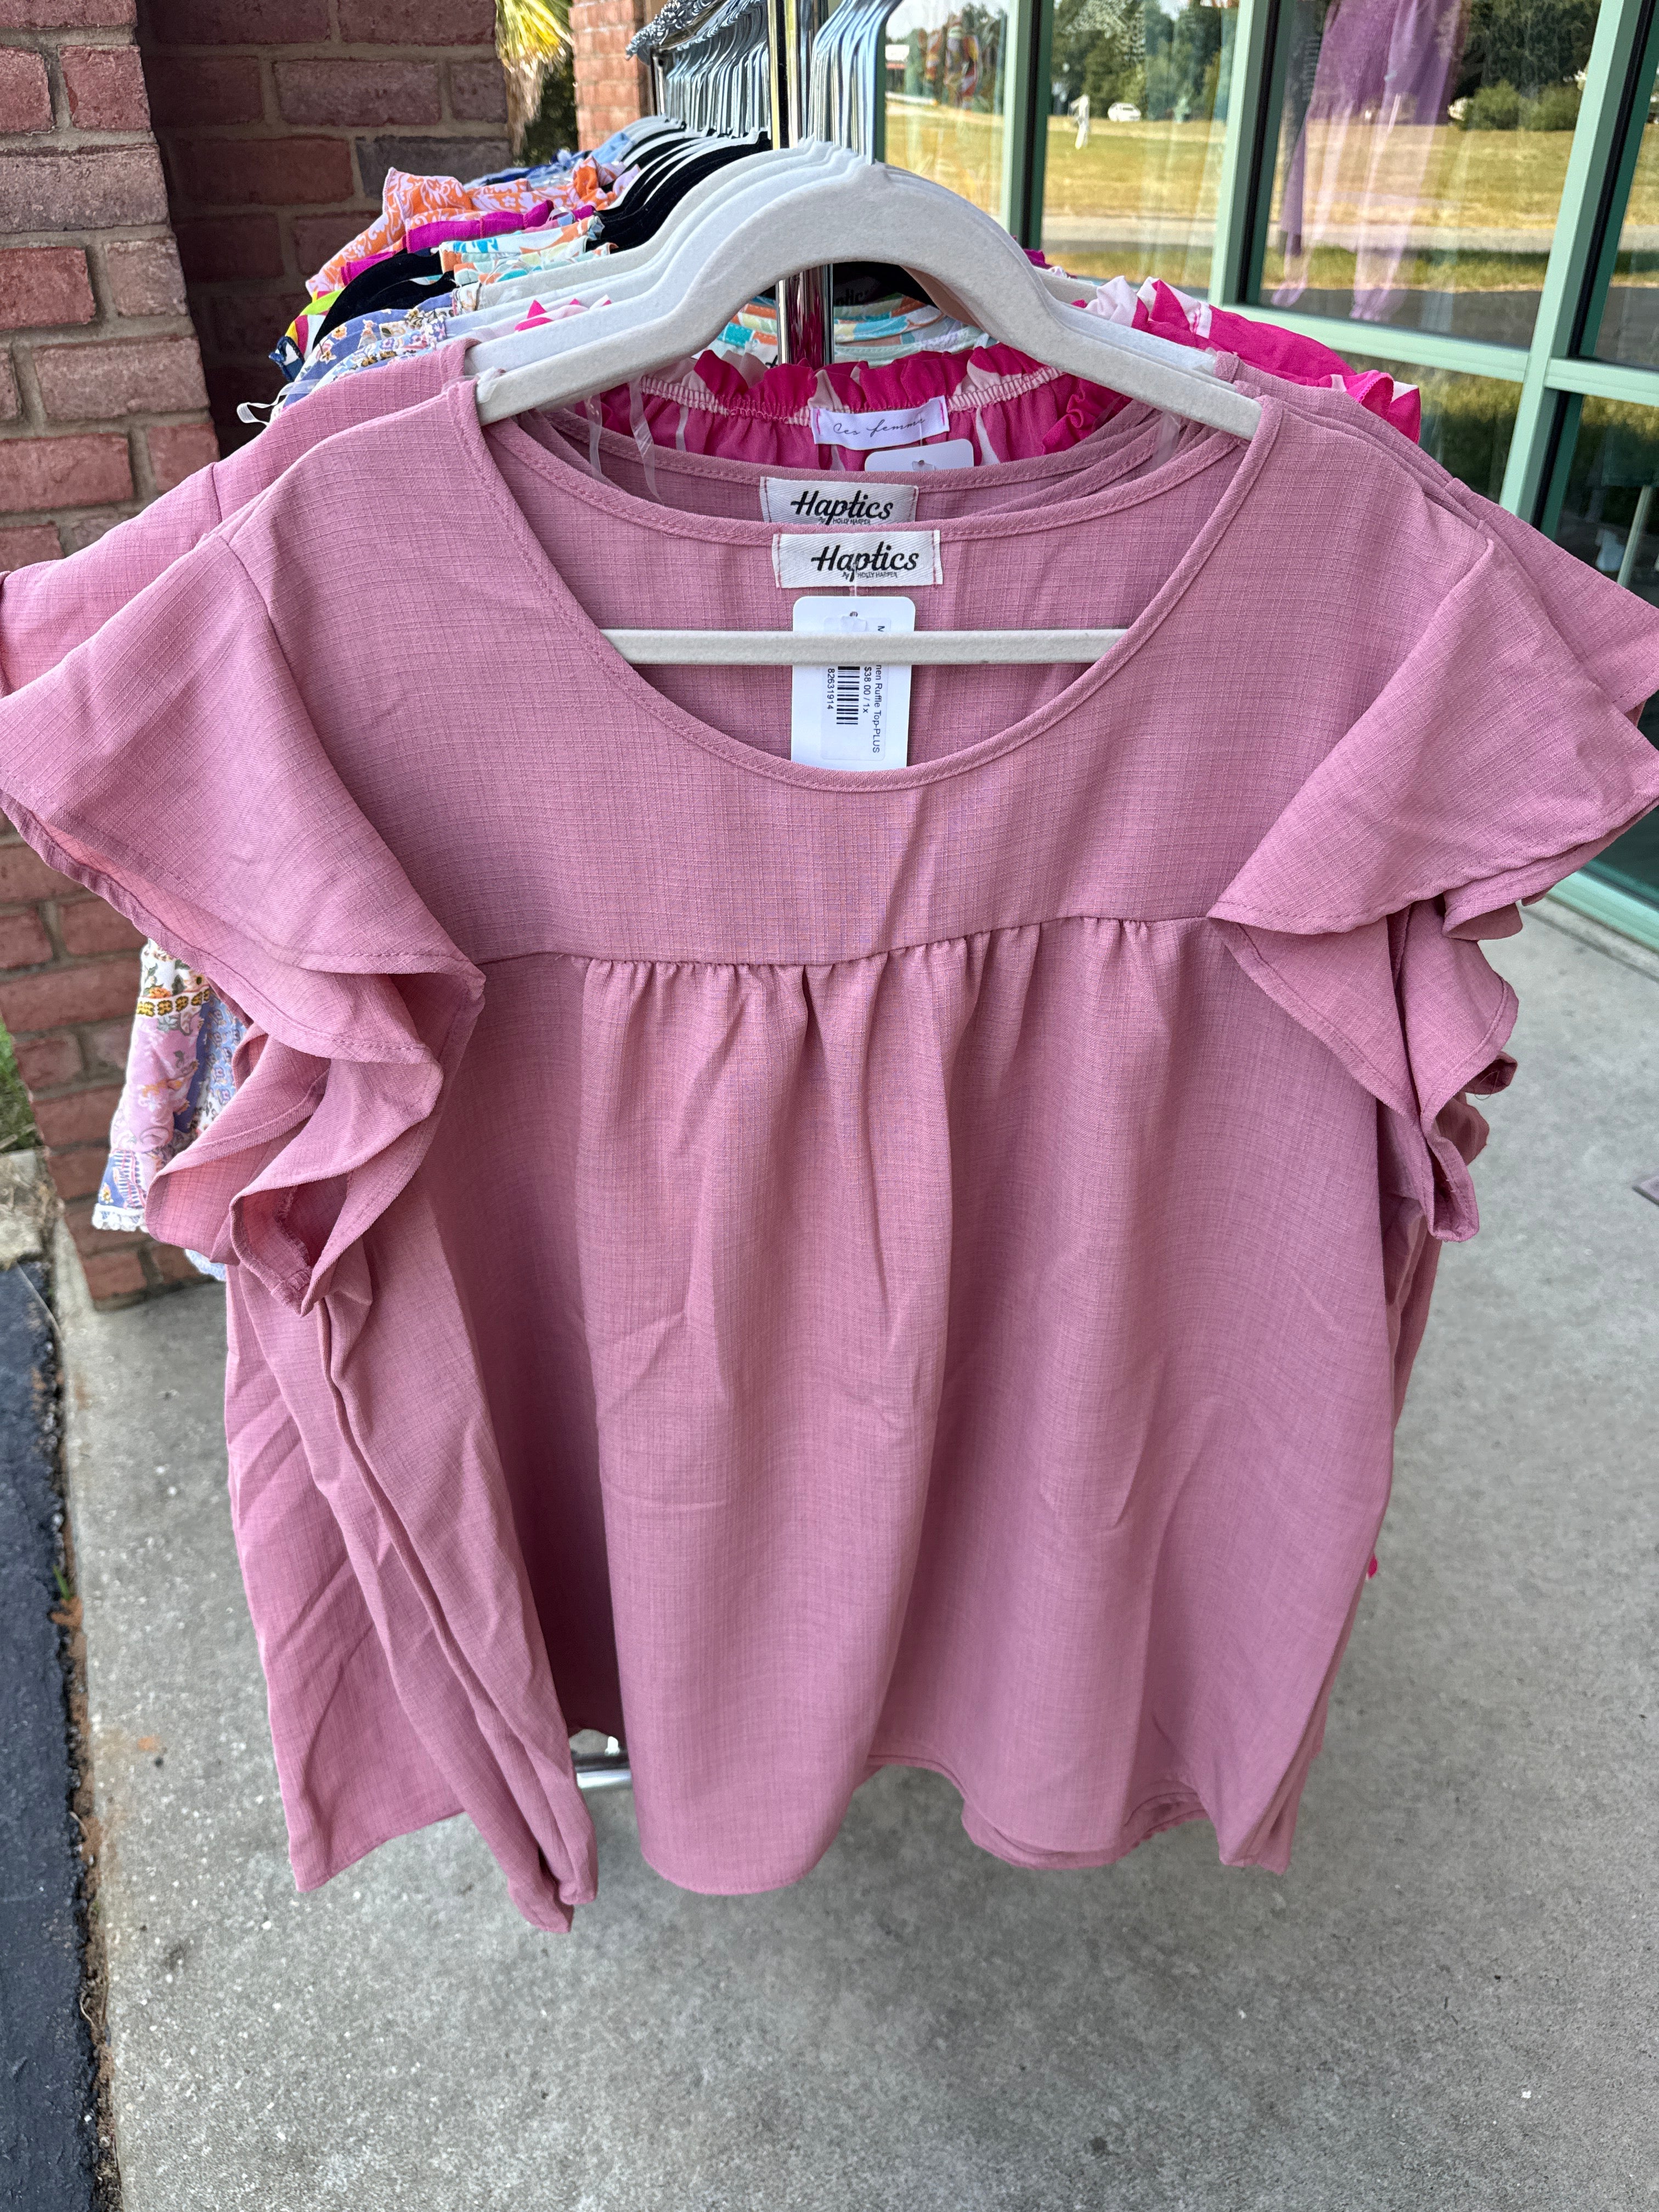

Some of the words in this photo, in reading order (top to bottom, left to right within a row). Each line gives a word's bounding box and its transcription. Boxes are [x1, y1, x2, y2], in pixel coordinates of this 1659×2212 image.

[866, 419, 926, 437] femme
[790, 489, 894, 526] Haptics
[810, 540, 919, 582] Haptics
[827, 668, 835, 709] 82631914
[874, 683, 883, 708] Ruffle
[862, 703, 870, 713] 1x
[872, 709, 882, 753] Top-PLUS
